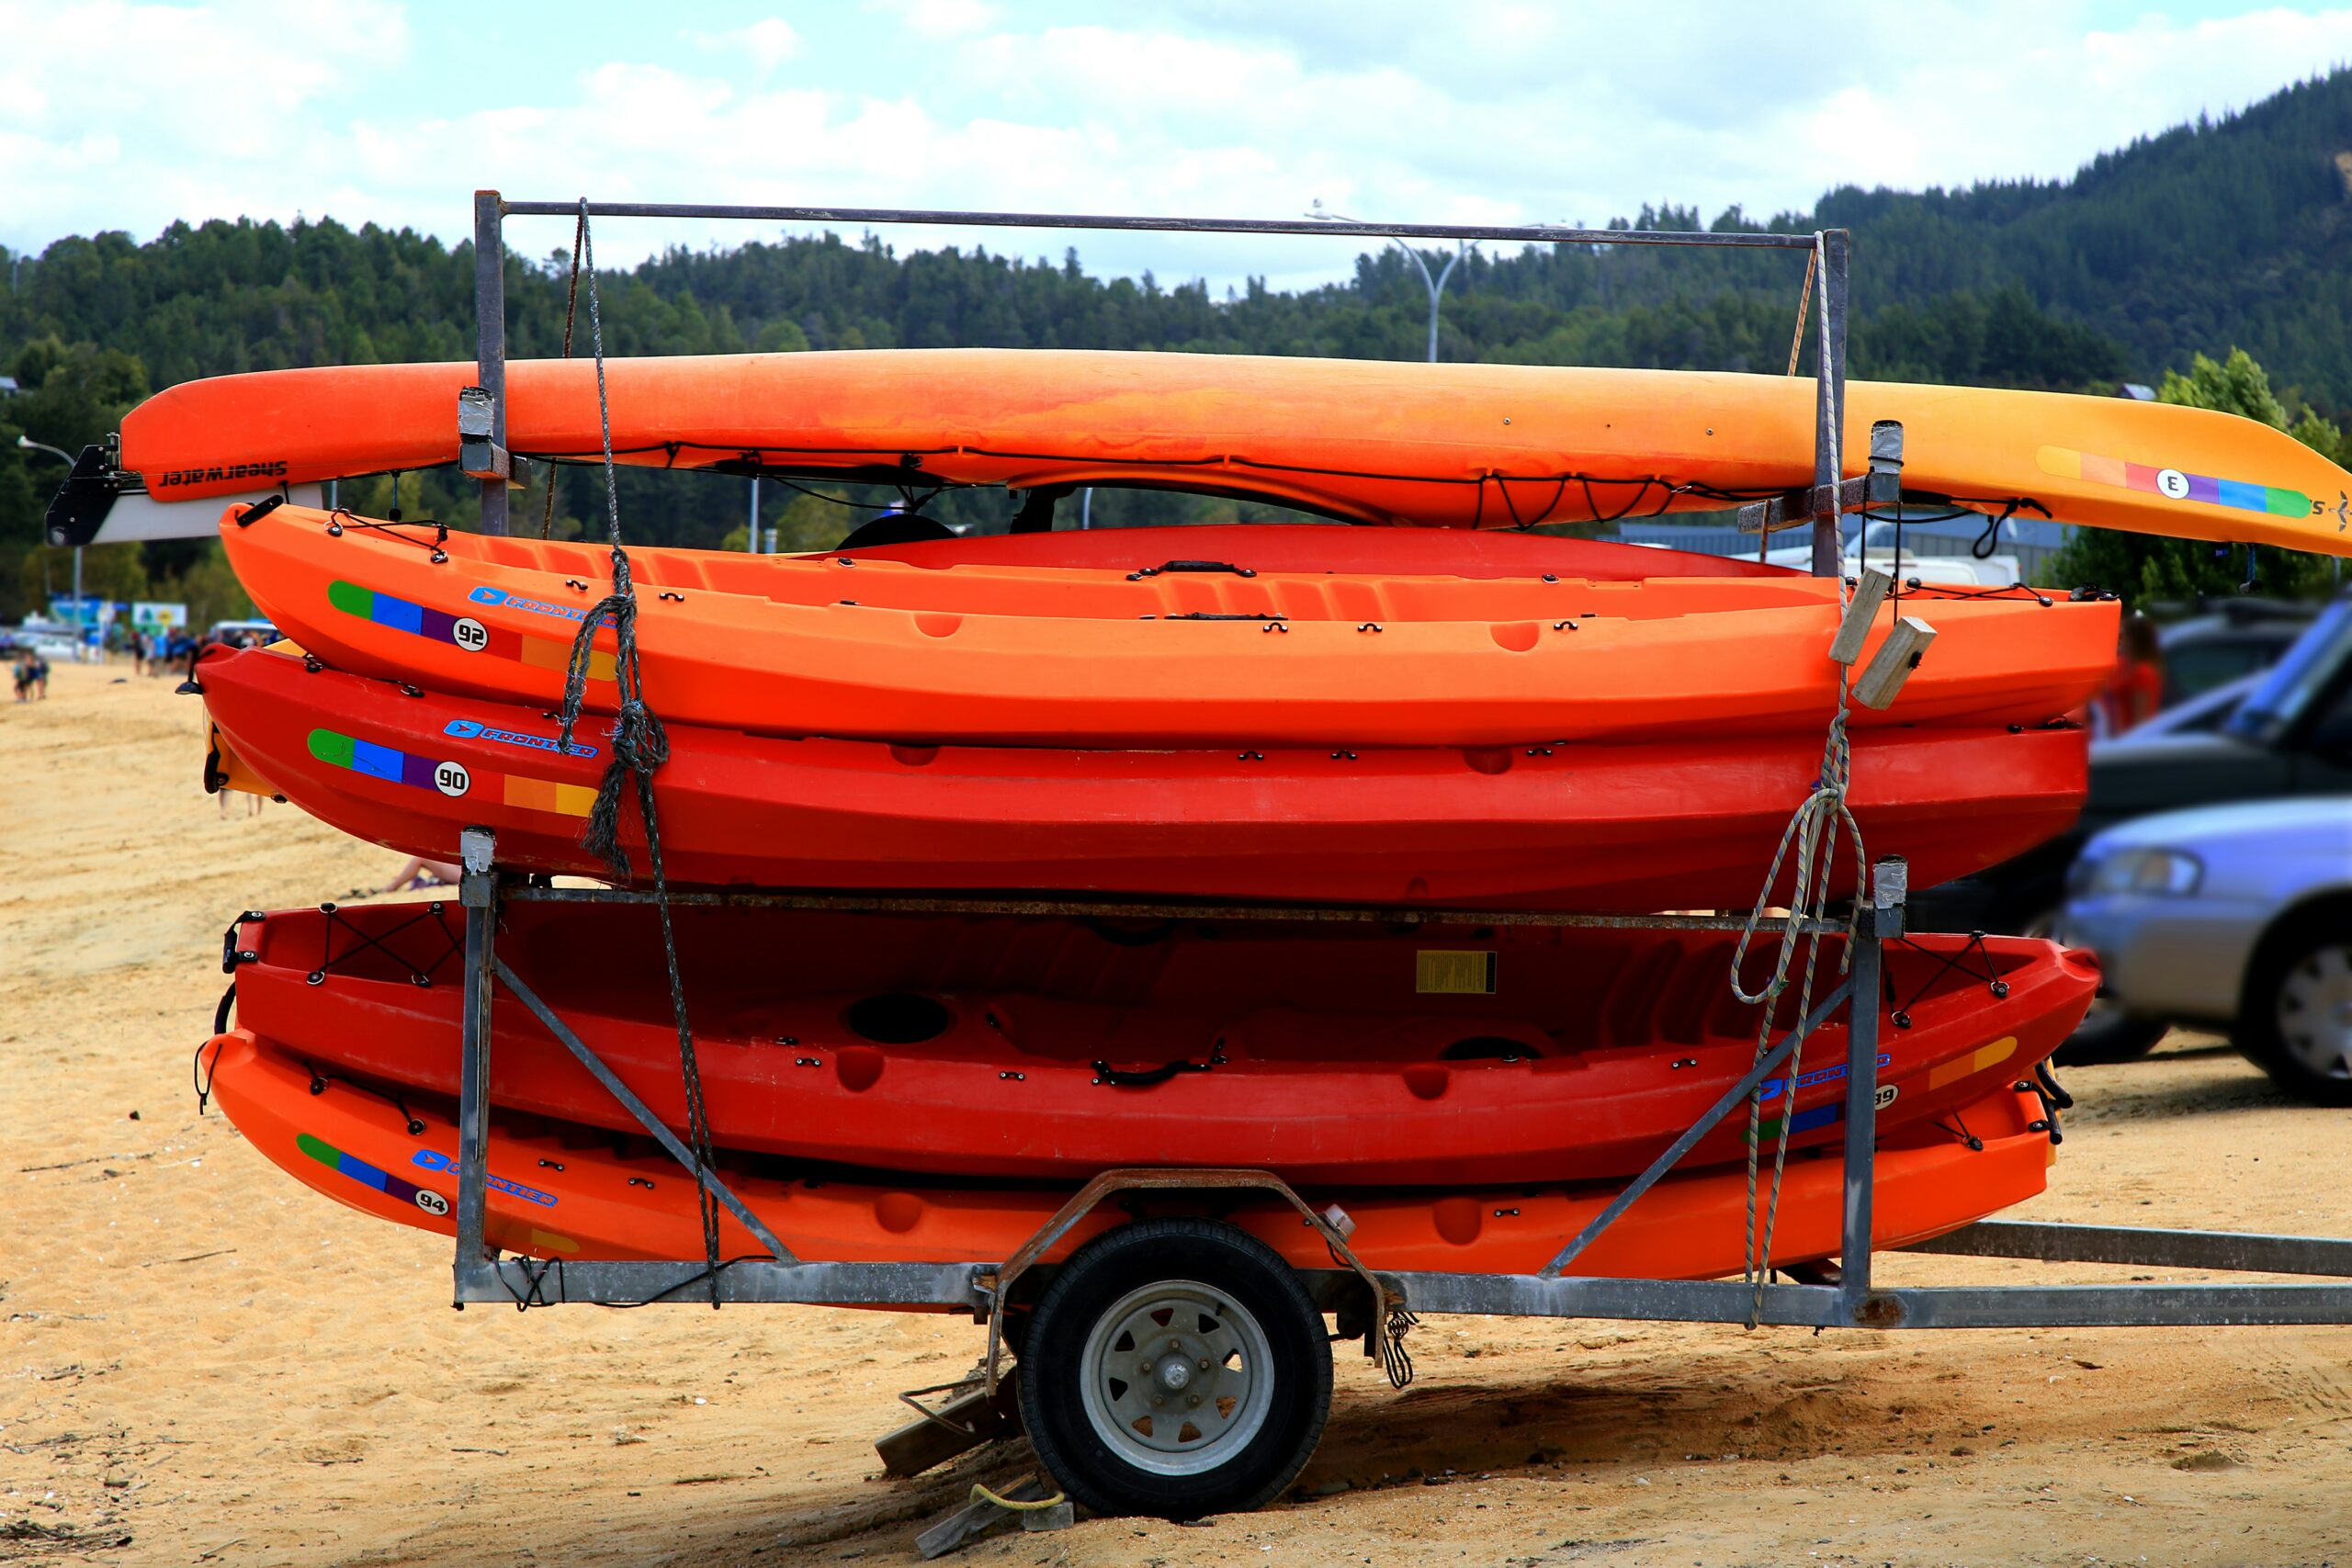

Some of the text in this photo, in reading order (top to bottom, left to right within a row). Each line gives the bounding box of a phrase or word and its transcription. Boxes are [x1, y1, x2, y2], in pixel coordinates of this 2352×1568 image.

[158, 461, 288, 487] Shearwater
[458, 624, 485, 647] 92
[481, 728, 598, 758] FRONTER
[439, 768, 466, 790] 90
[447, 1162, 558, 1208] FNTIER
[419, 1193, 446, 1213] 94
